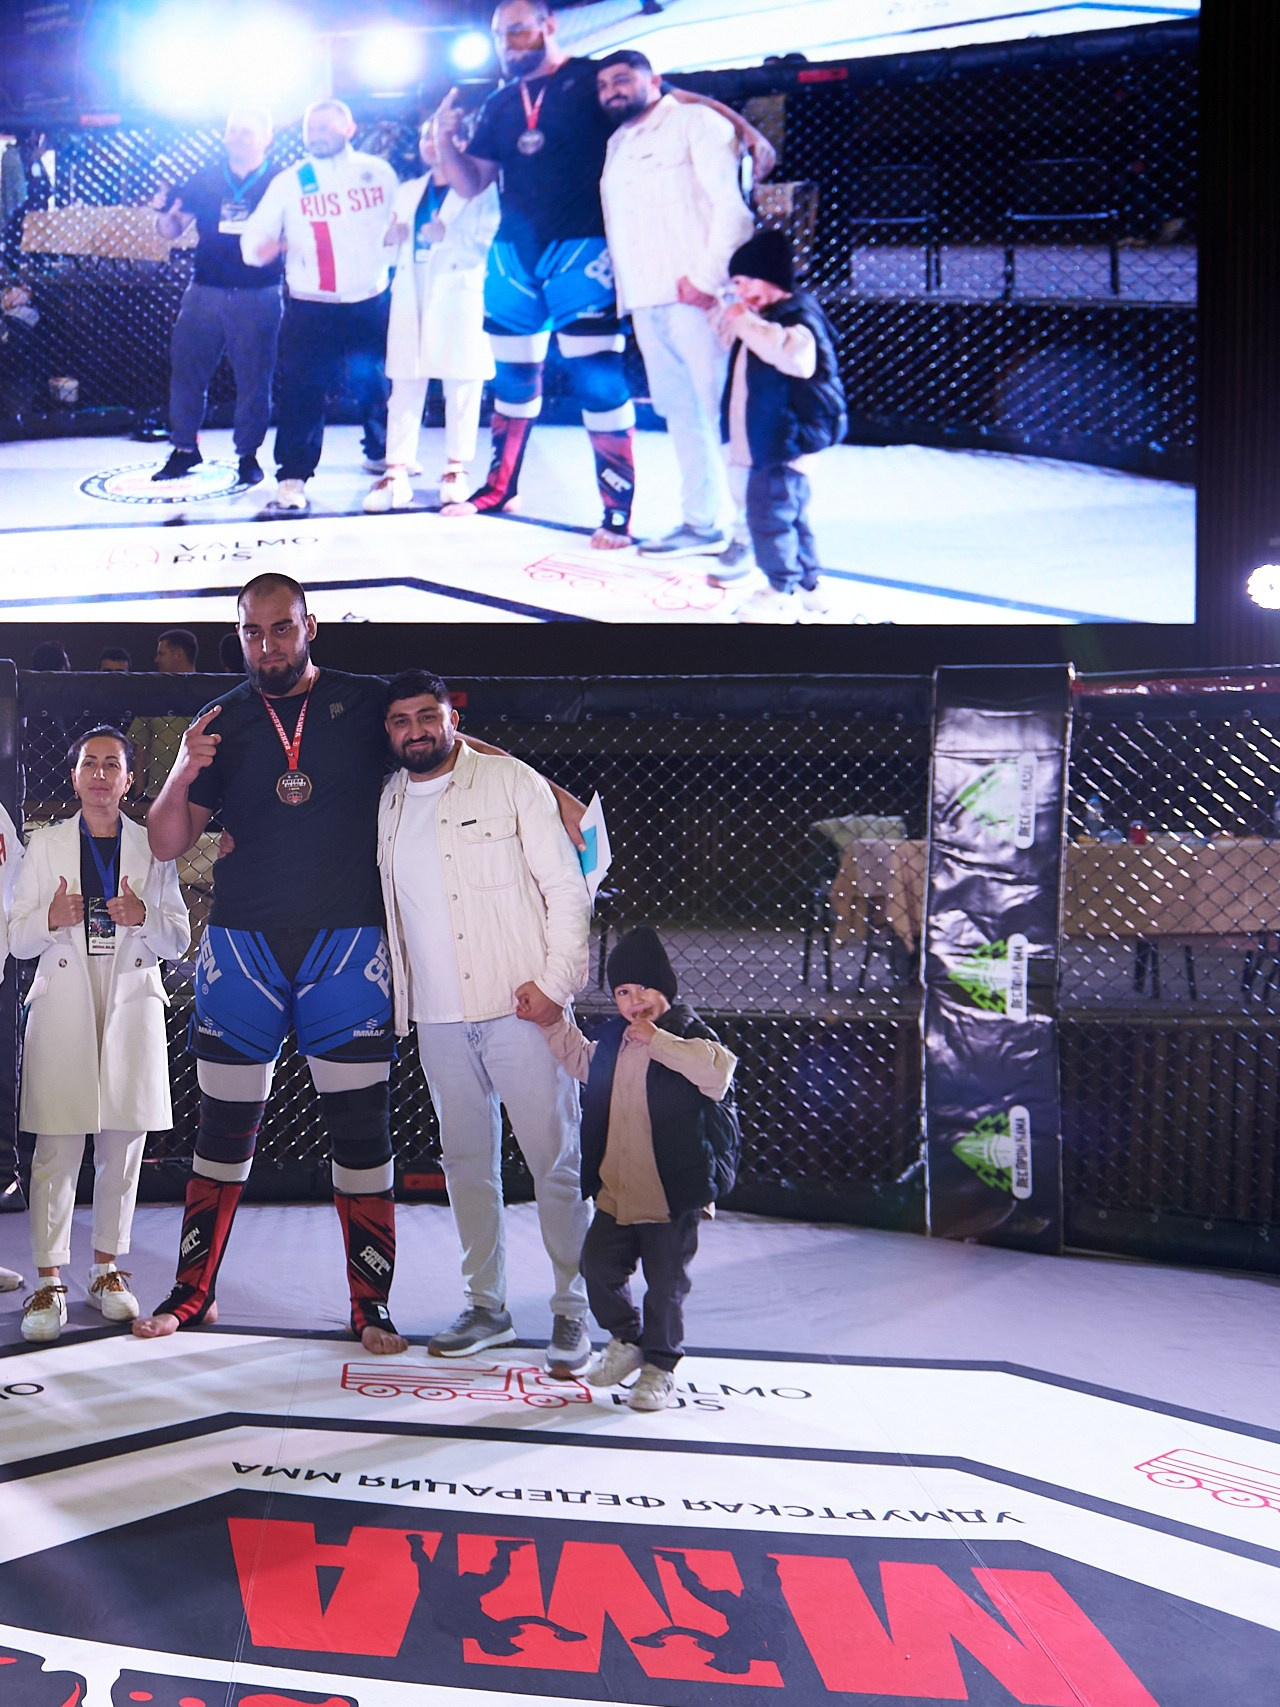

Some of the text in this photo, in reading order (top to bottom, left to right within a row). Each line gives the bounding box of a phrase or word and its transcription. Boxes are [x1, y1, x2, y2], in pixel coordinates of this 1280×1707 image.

[300, 191, 342, 217] RUS
[179, 536, 319, 551] VALMO
[172, 551, 253, 564] RUS
[200, 924, 222, 985] EEN
[198, 1025, 224, 1038] MMAF
[353, 1029, 385, 1037] IMMAF
[359, 1250, 383, 1277] HILL
[365, 1245, 392, 1273] GREEN
[231, 1461, 1026, 1524] УДМУРТСКАЯ ФЕДЕРАЦИЯ ММА
